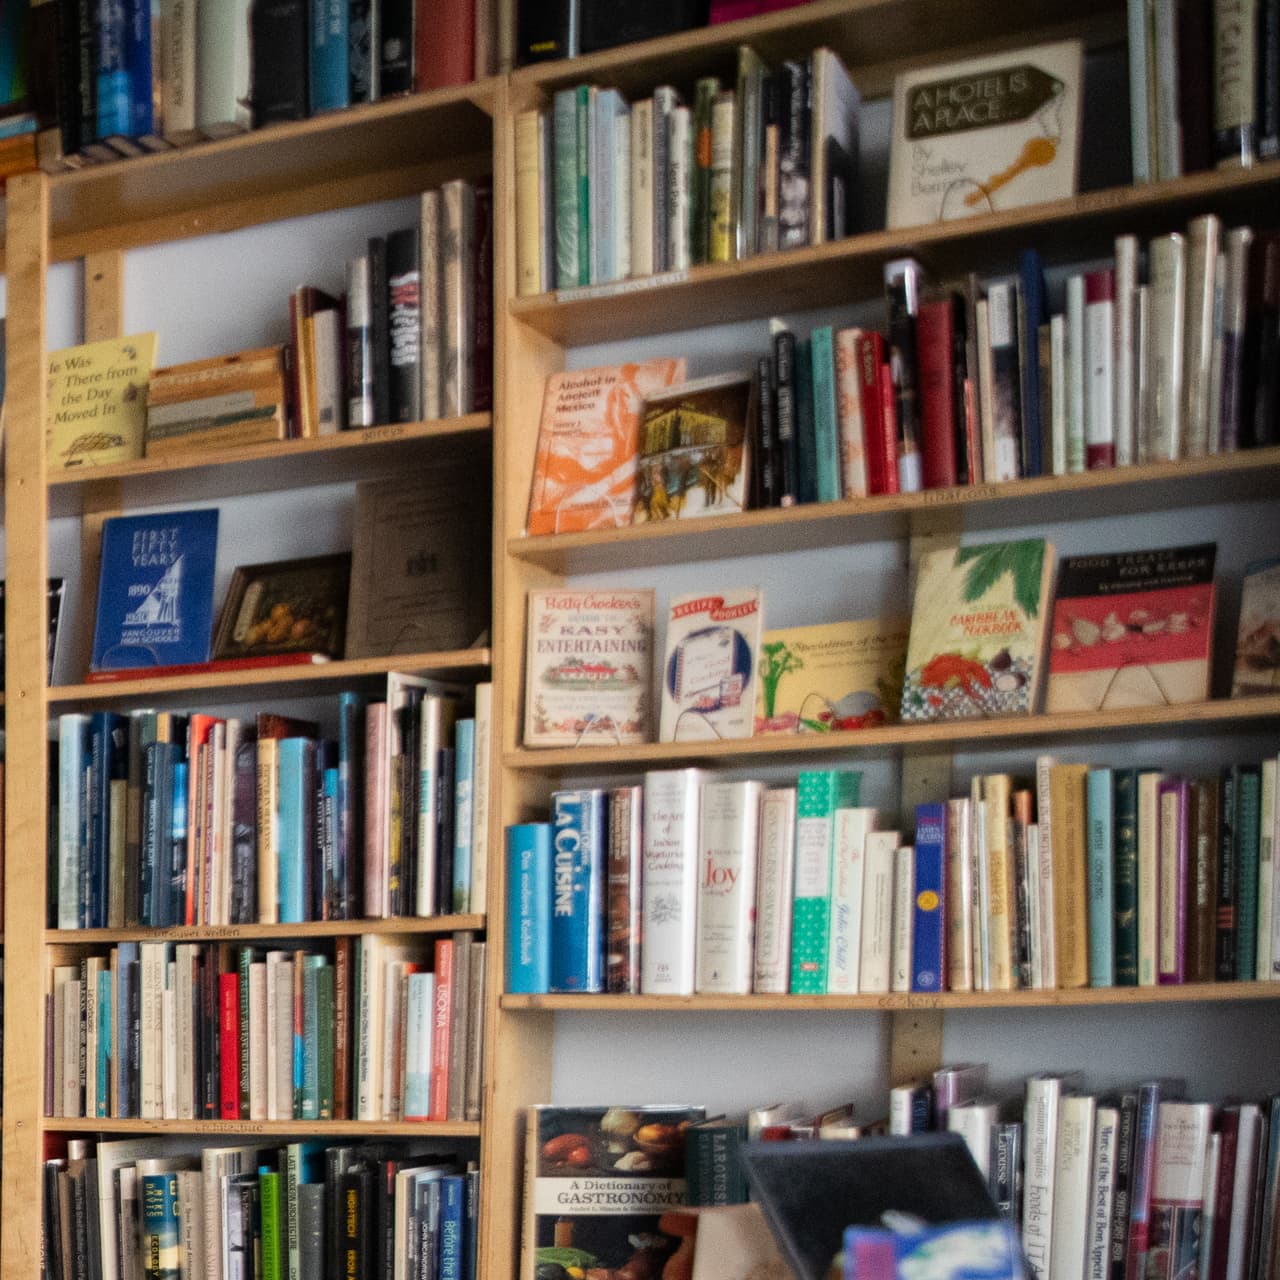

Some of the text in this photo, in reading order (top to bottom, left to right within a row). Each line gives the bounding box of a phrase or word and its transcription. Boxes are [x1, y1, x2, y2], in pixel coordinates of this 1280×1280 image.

[913, 73, 1029, 108] A HOTEL IS
[913, 115, 930, 132] A
[66, 365, 139, 388] There from
[559, 375, 616, 390] Alcohol in
[62, 386, 113, 407] the Day
[558, 388, 601, 402] Ancient
[54, 404, 117, 425] Moved In
[556, 402, 596, 413] Mexico
[132, 528, 180, 542] FIRST
[132, 540, 177, 554] FIFTY
[131, 553, 177, 568] YEARS
[127, 584, 152, 598] 1890
[545, 594, 642, 613] Betty Crocker's
[950, 610, 1019, 628] CARIBBEAN
[121, 628, 181, 639] VANCOUVER
[560, 625, 626, 636] EASY
[963, 621, 1023, 637] COOKBOOK
[538, 638, 647, 654] ENTERTAINING
[437, 986, 448, 1028] USONIA
[1101, 1125, 1113, 1147] More
[998, 1132, 1007, 1185] Larousse
[1101, 1148, 1111, 1159] of
[1100, 1162, 1110, 1178] the
[570, 1180, 672, 1193] A Dictionary of
[1098, 1182, 1109, 1202] Best
[145, 1183, 153, 1217] DAVIS
[557, 1192, 685, 1205] GASTRONOMY
[1096, 1217, 1107, 1237] Bon
[443, 1220, 456, 1255] Before
[151, 1234, 160, 1278] ECOLOGY
[443, 1257, 456, 1275] the
